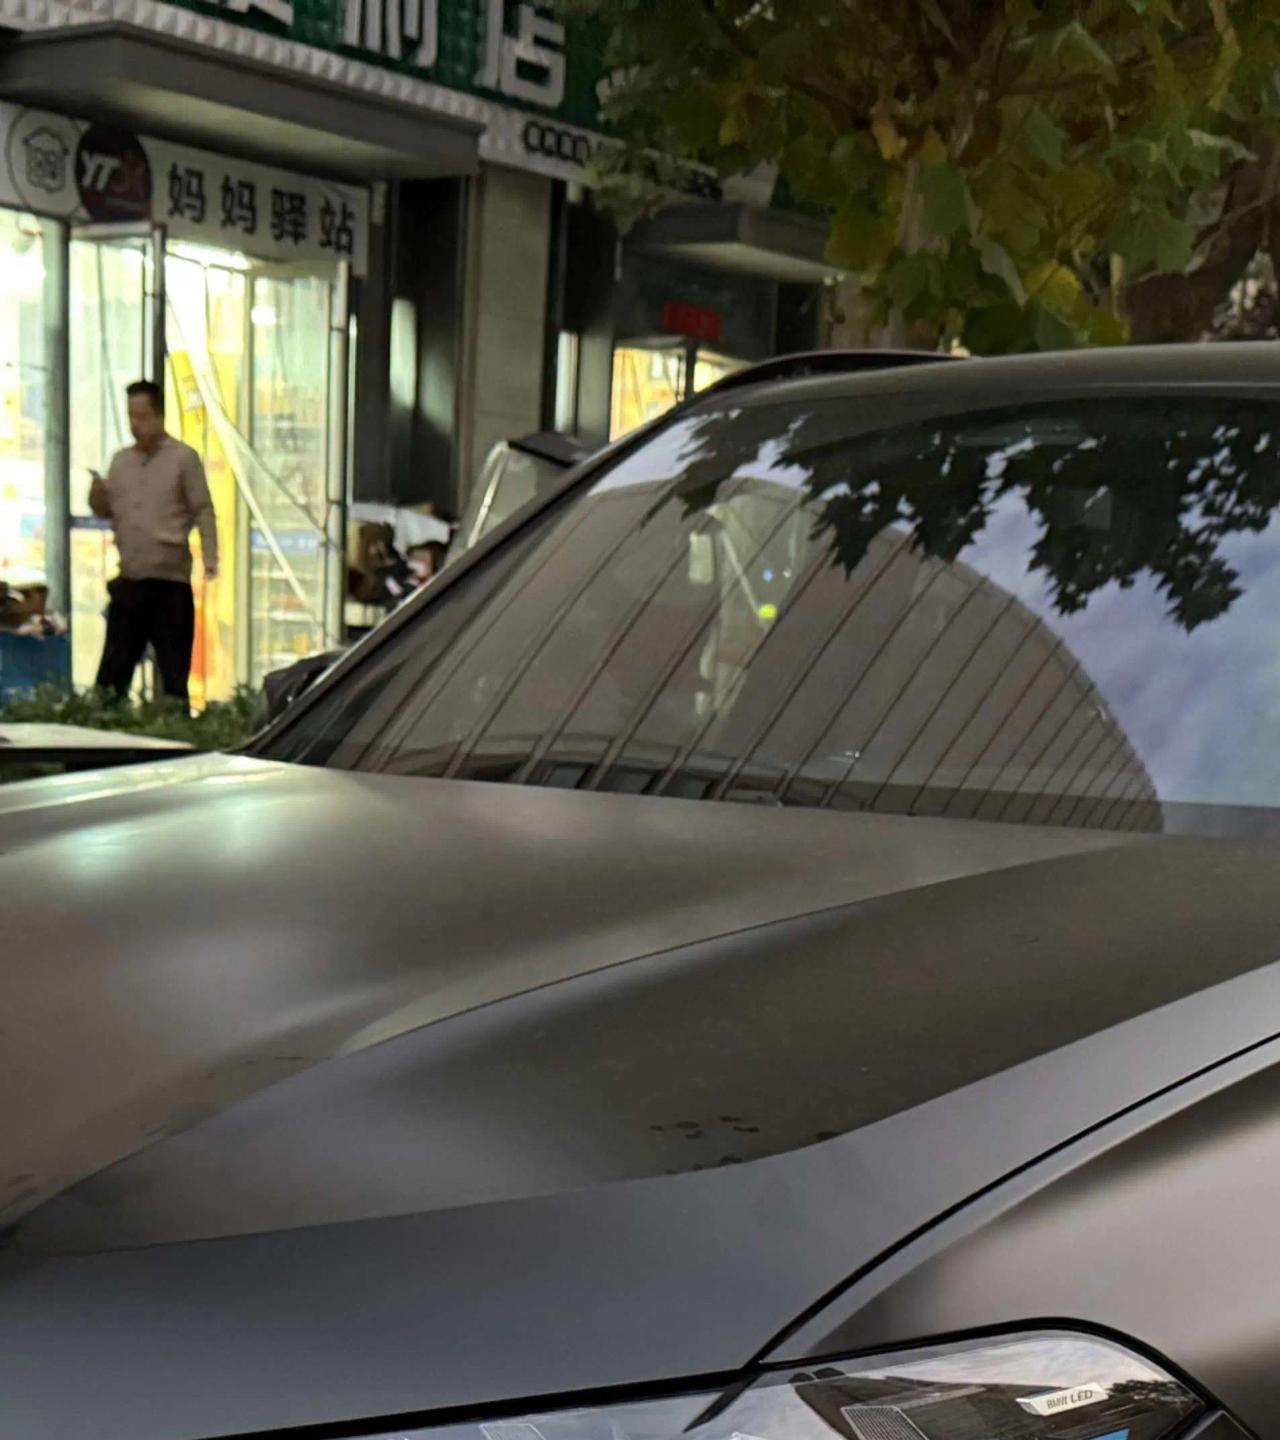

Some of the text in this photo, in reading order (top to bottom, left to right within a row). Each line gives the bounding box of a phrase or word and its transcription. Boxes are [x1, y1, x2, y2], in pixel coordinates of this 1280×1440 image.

[168, 162, 354, 256] 妈妈驿站
[1070, 1389, 1093, 1403] LED
